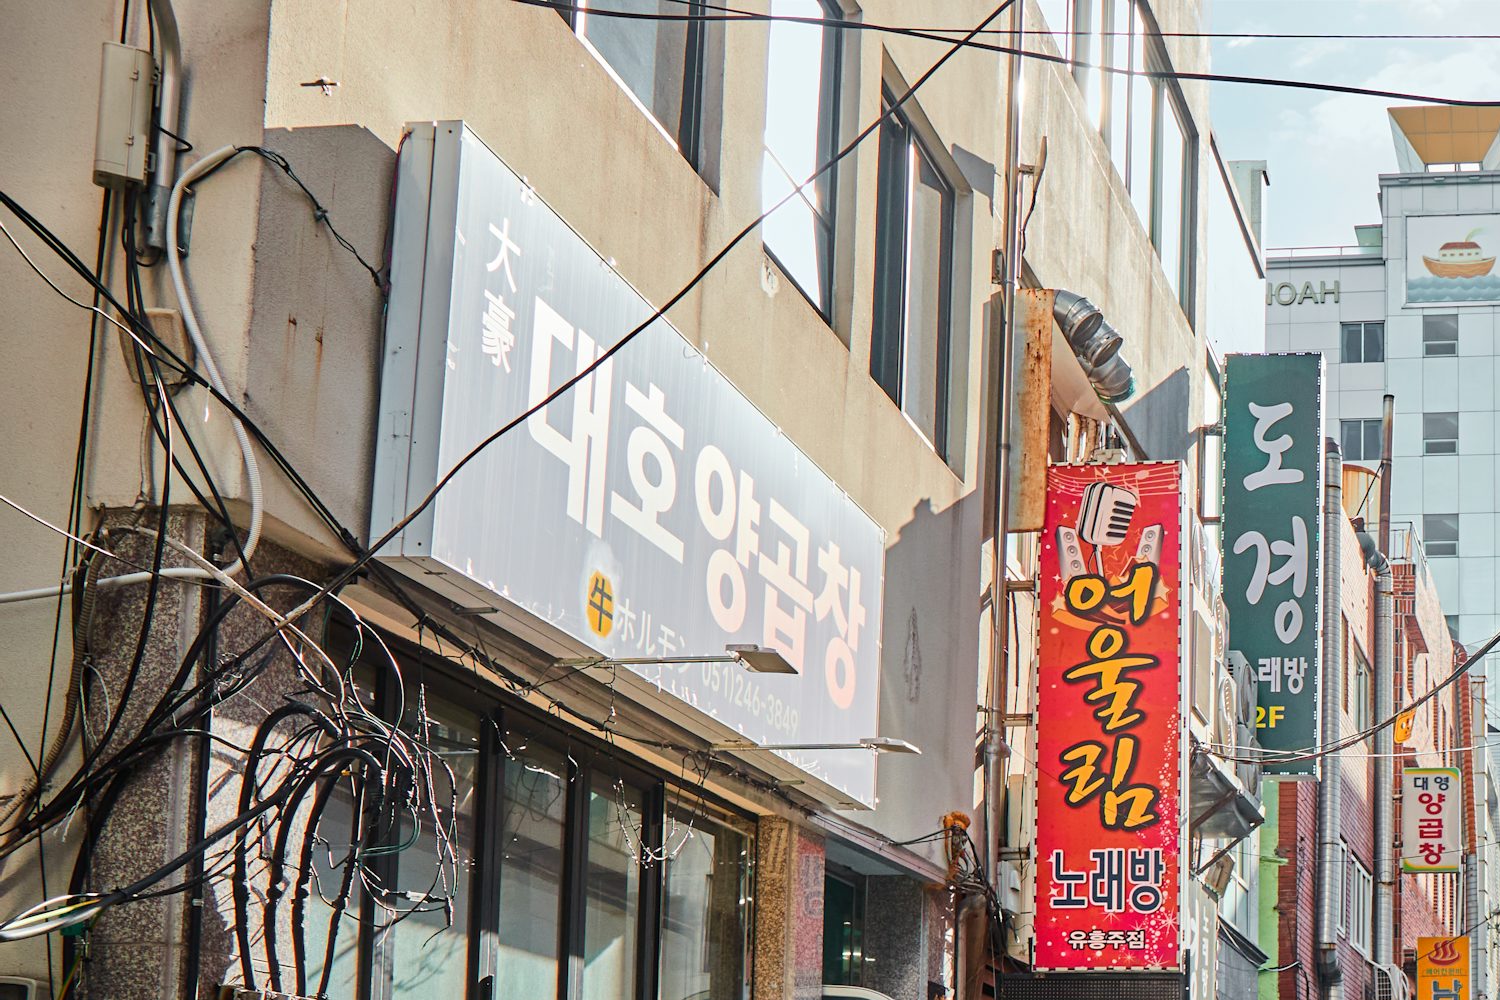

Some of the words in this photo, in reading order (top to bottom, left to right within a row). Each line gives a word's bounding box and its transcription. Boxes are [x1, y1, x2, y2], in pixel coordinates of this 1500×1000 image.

[483, 217, 521, 373] 大豪
[528, 296, 866, 710] 대호양곱창
[1232, 401, 1309, 644] 도경
[588, 577, 614, 633] 牛
[1059, 562, 1161, 832] 어울림
[1257, 656, 1309, 696] 래방
[1252, 705, 1285, 730] 2F
[1413, 776, 1450, 792] 대영
[1418, 792, 1446, 866] 양곱창
[1049, 847, 1165, 914] 노래방
[1068, 929, 1146, 952] 유흥주점
